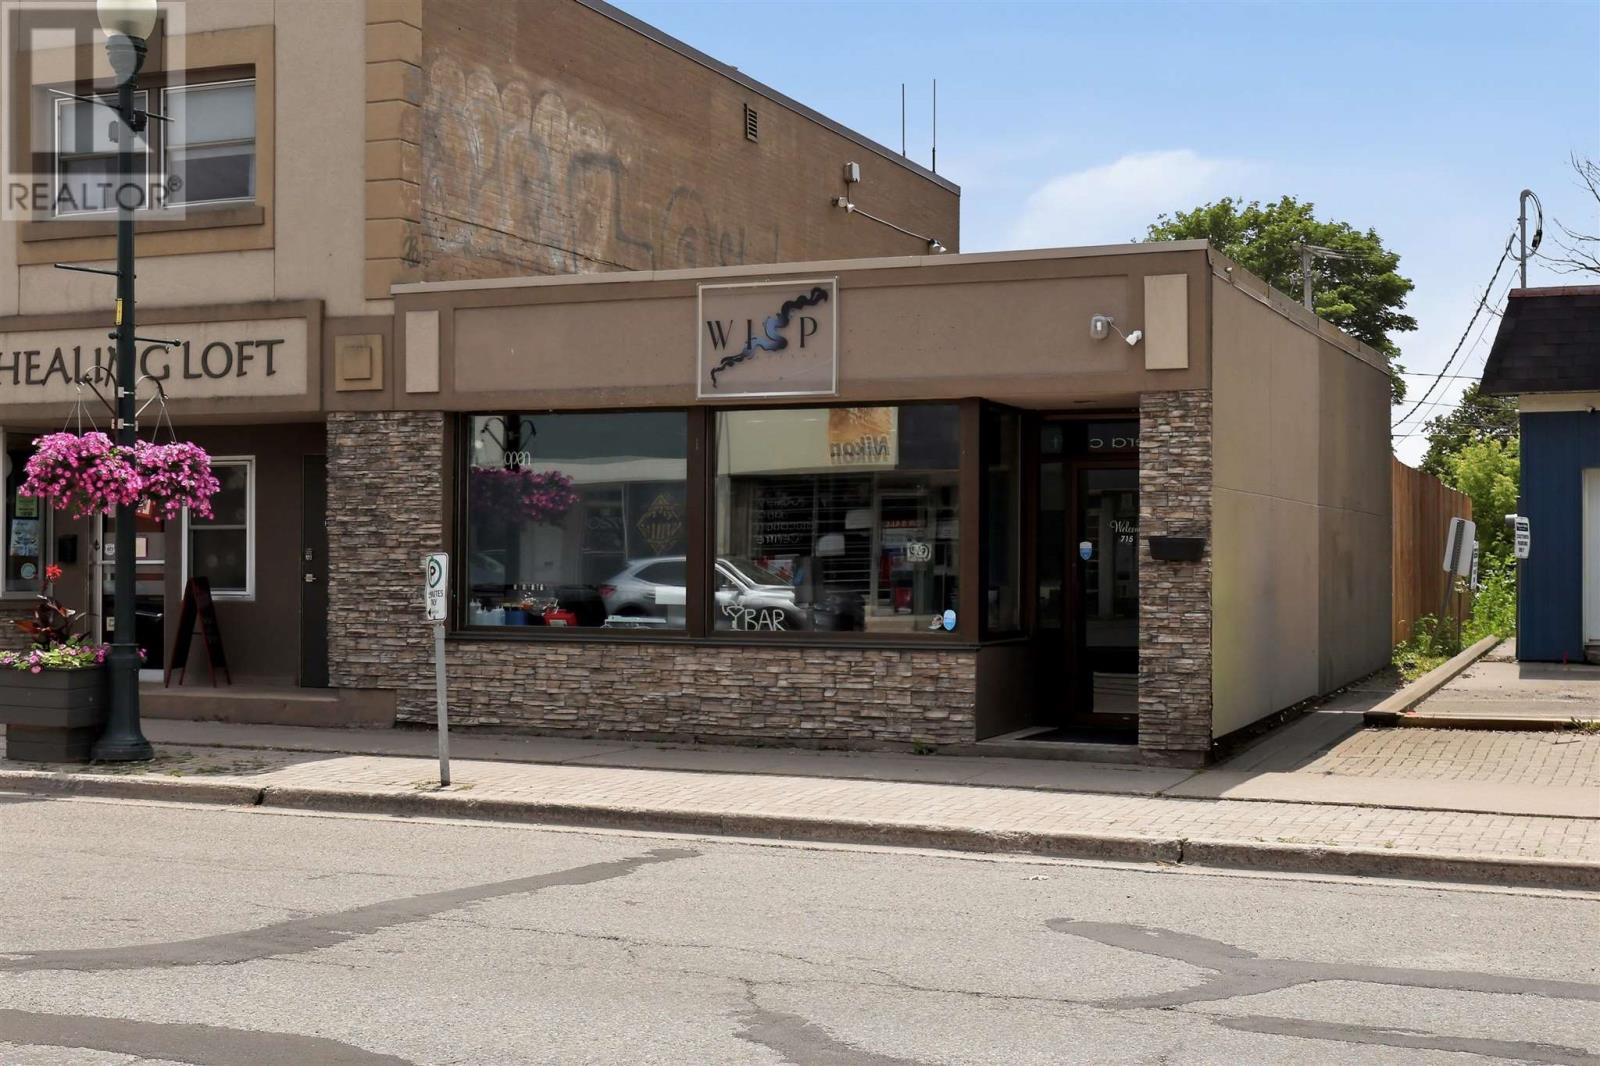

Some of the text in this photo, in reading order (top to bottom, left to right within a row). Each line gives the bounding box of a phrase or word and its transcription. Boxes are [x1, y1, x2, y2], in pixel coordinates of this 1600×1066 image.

[182, 339, 285, 379] LOFT
[504, 451, 530, 470] open
[745, 608, 786, 632] BAR
